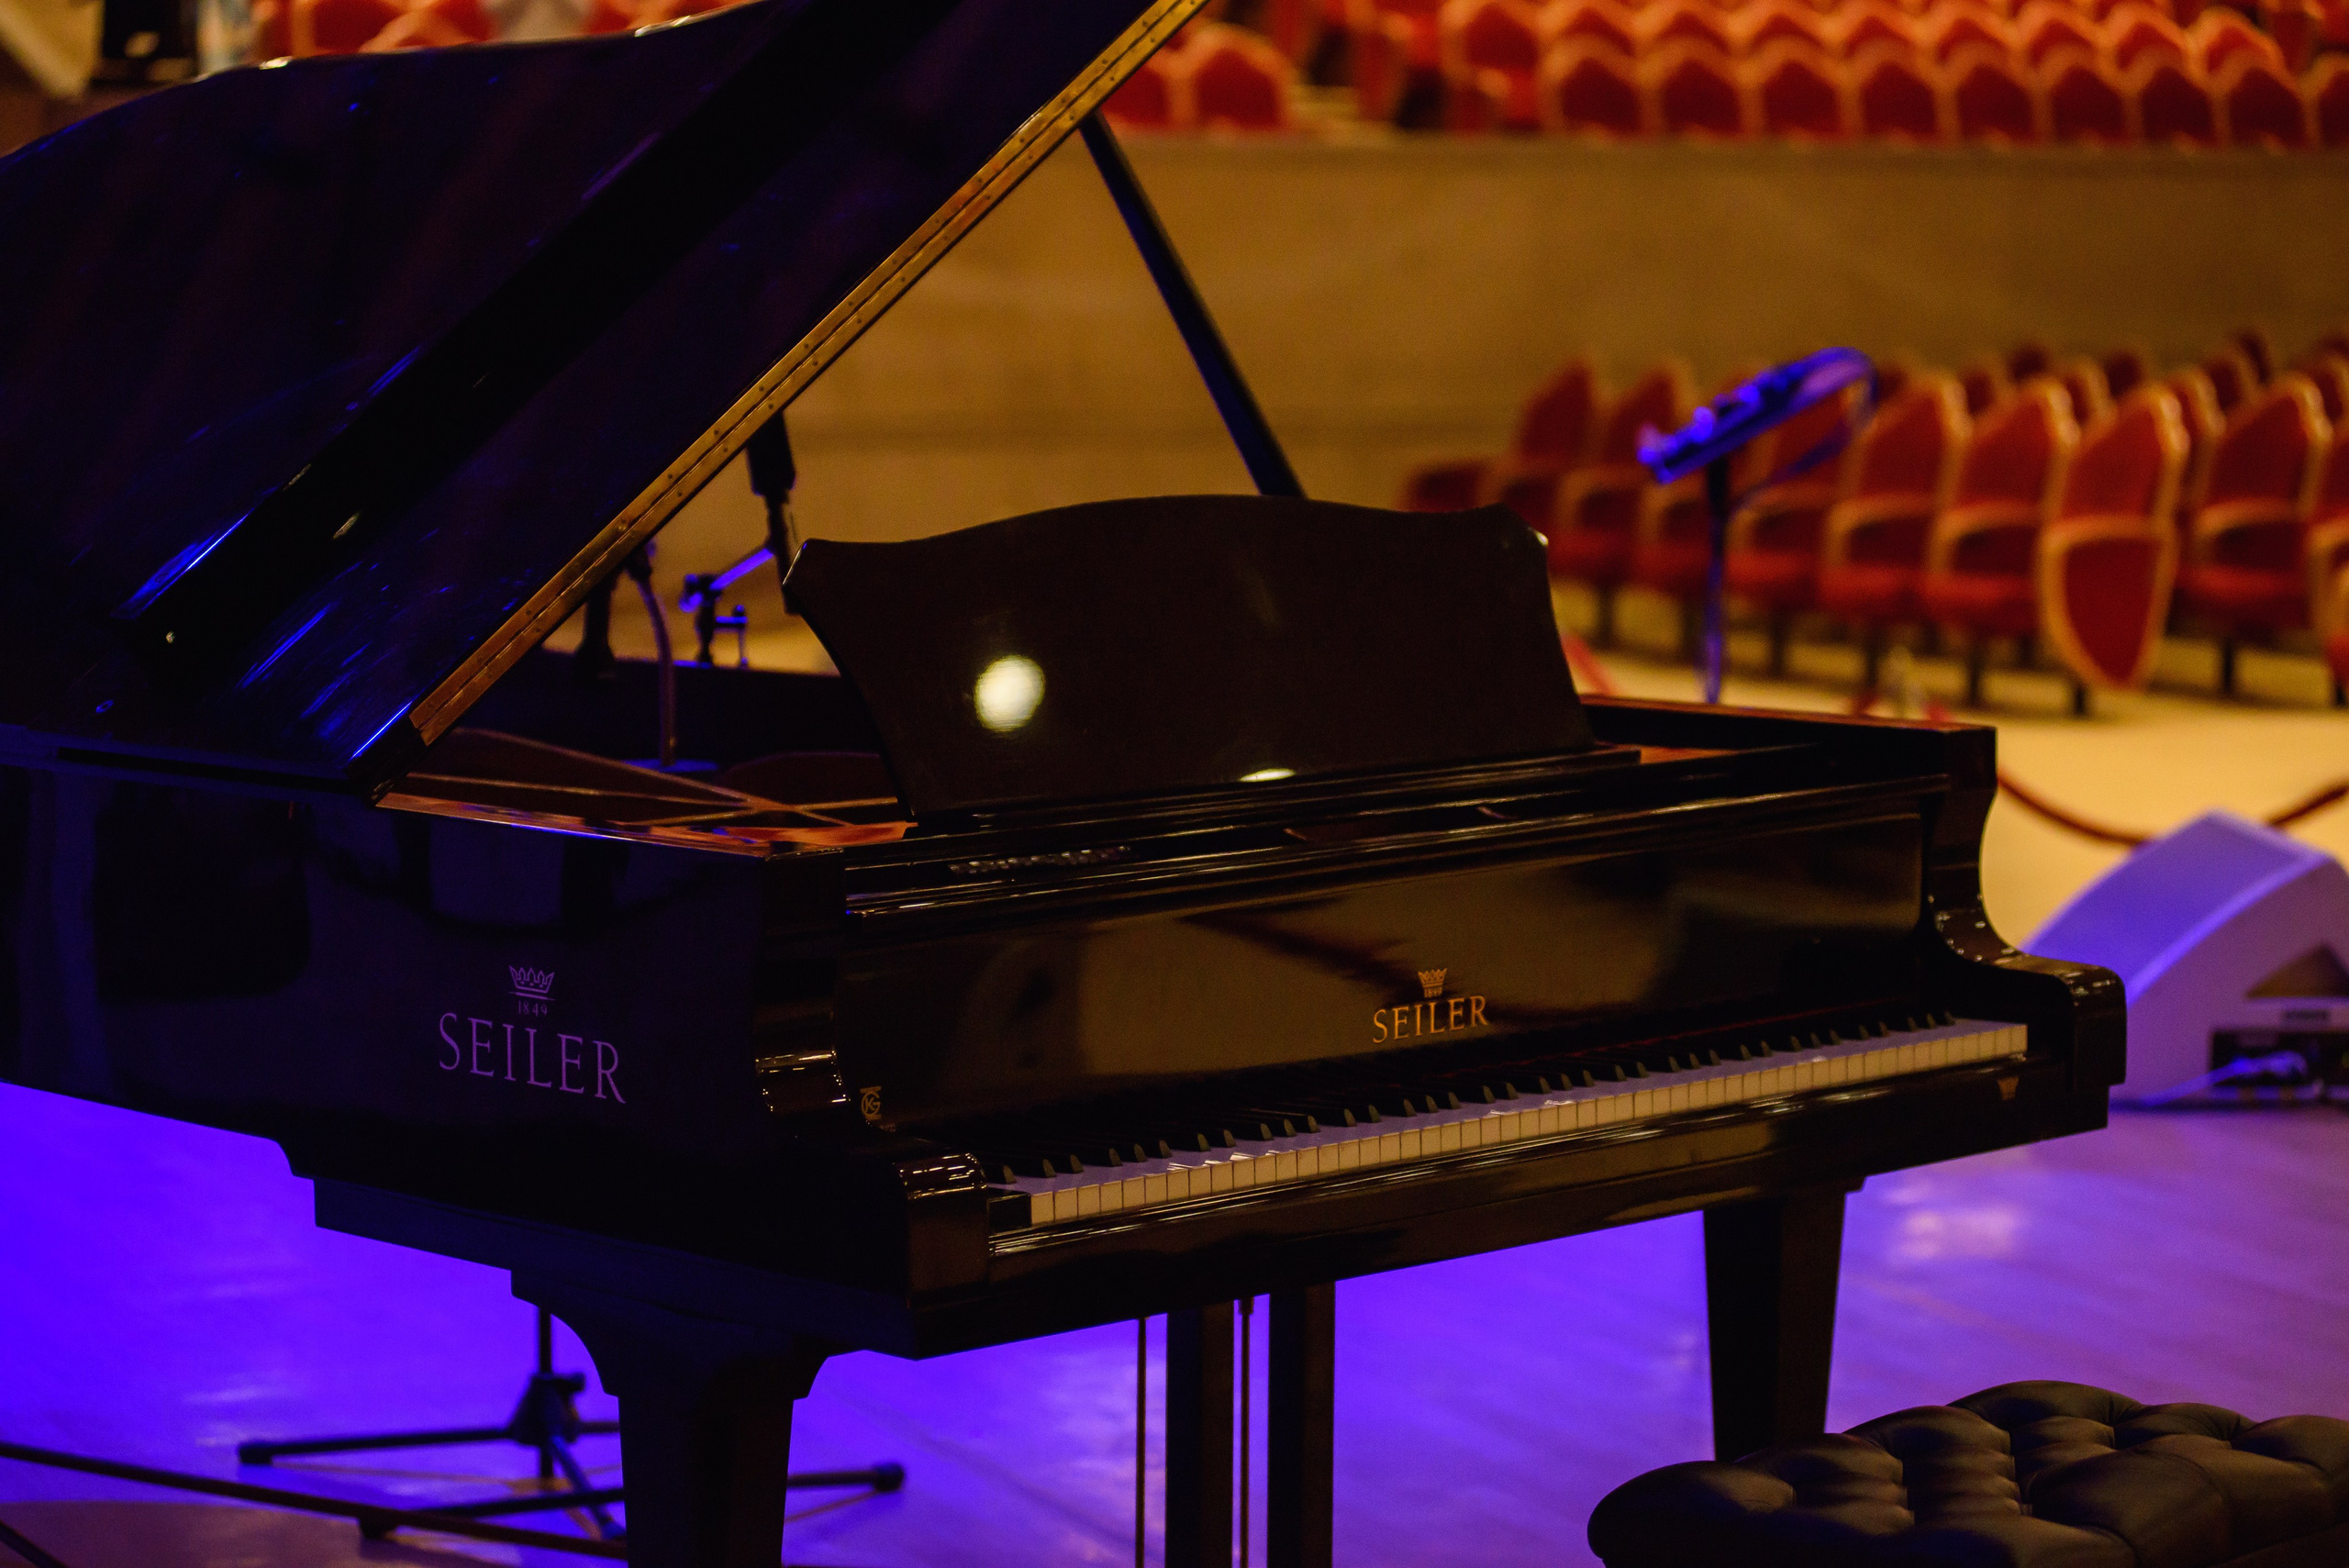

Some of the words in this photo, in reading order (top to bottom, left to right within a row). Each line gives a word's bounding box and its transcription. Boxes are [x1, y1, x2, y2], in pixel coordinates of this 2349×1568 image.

[518, 999, 549, 1018] 1849
[1373, 995, 1488, 1044] SEILER
[439, 1012, 626, 1104] SEILER
